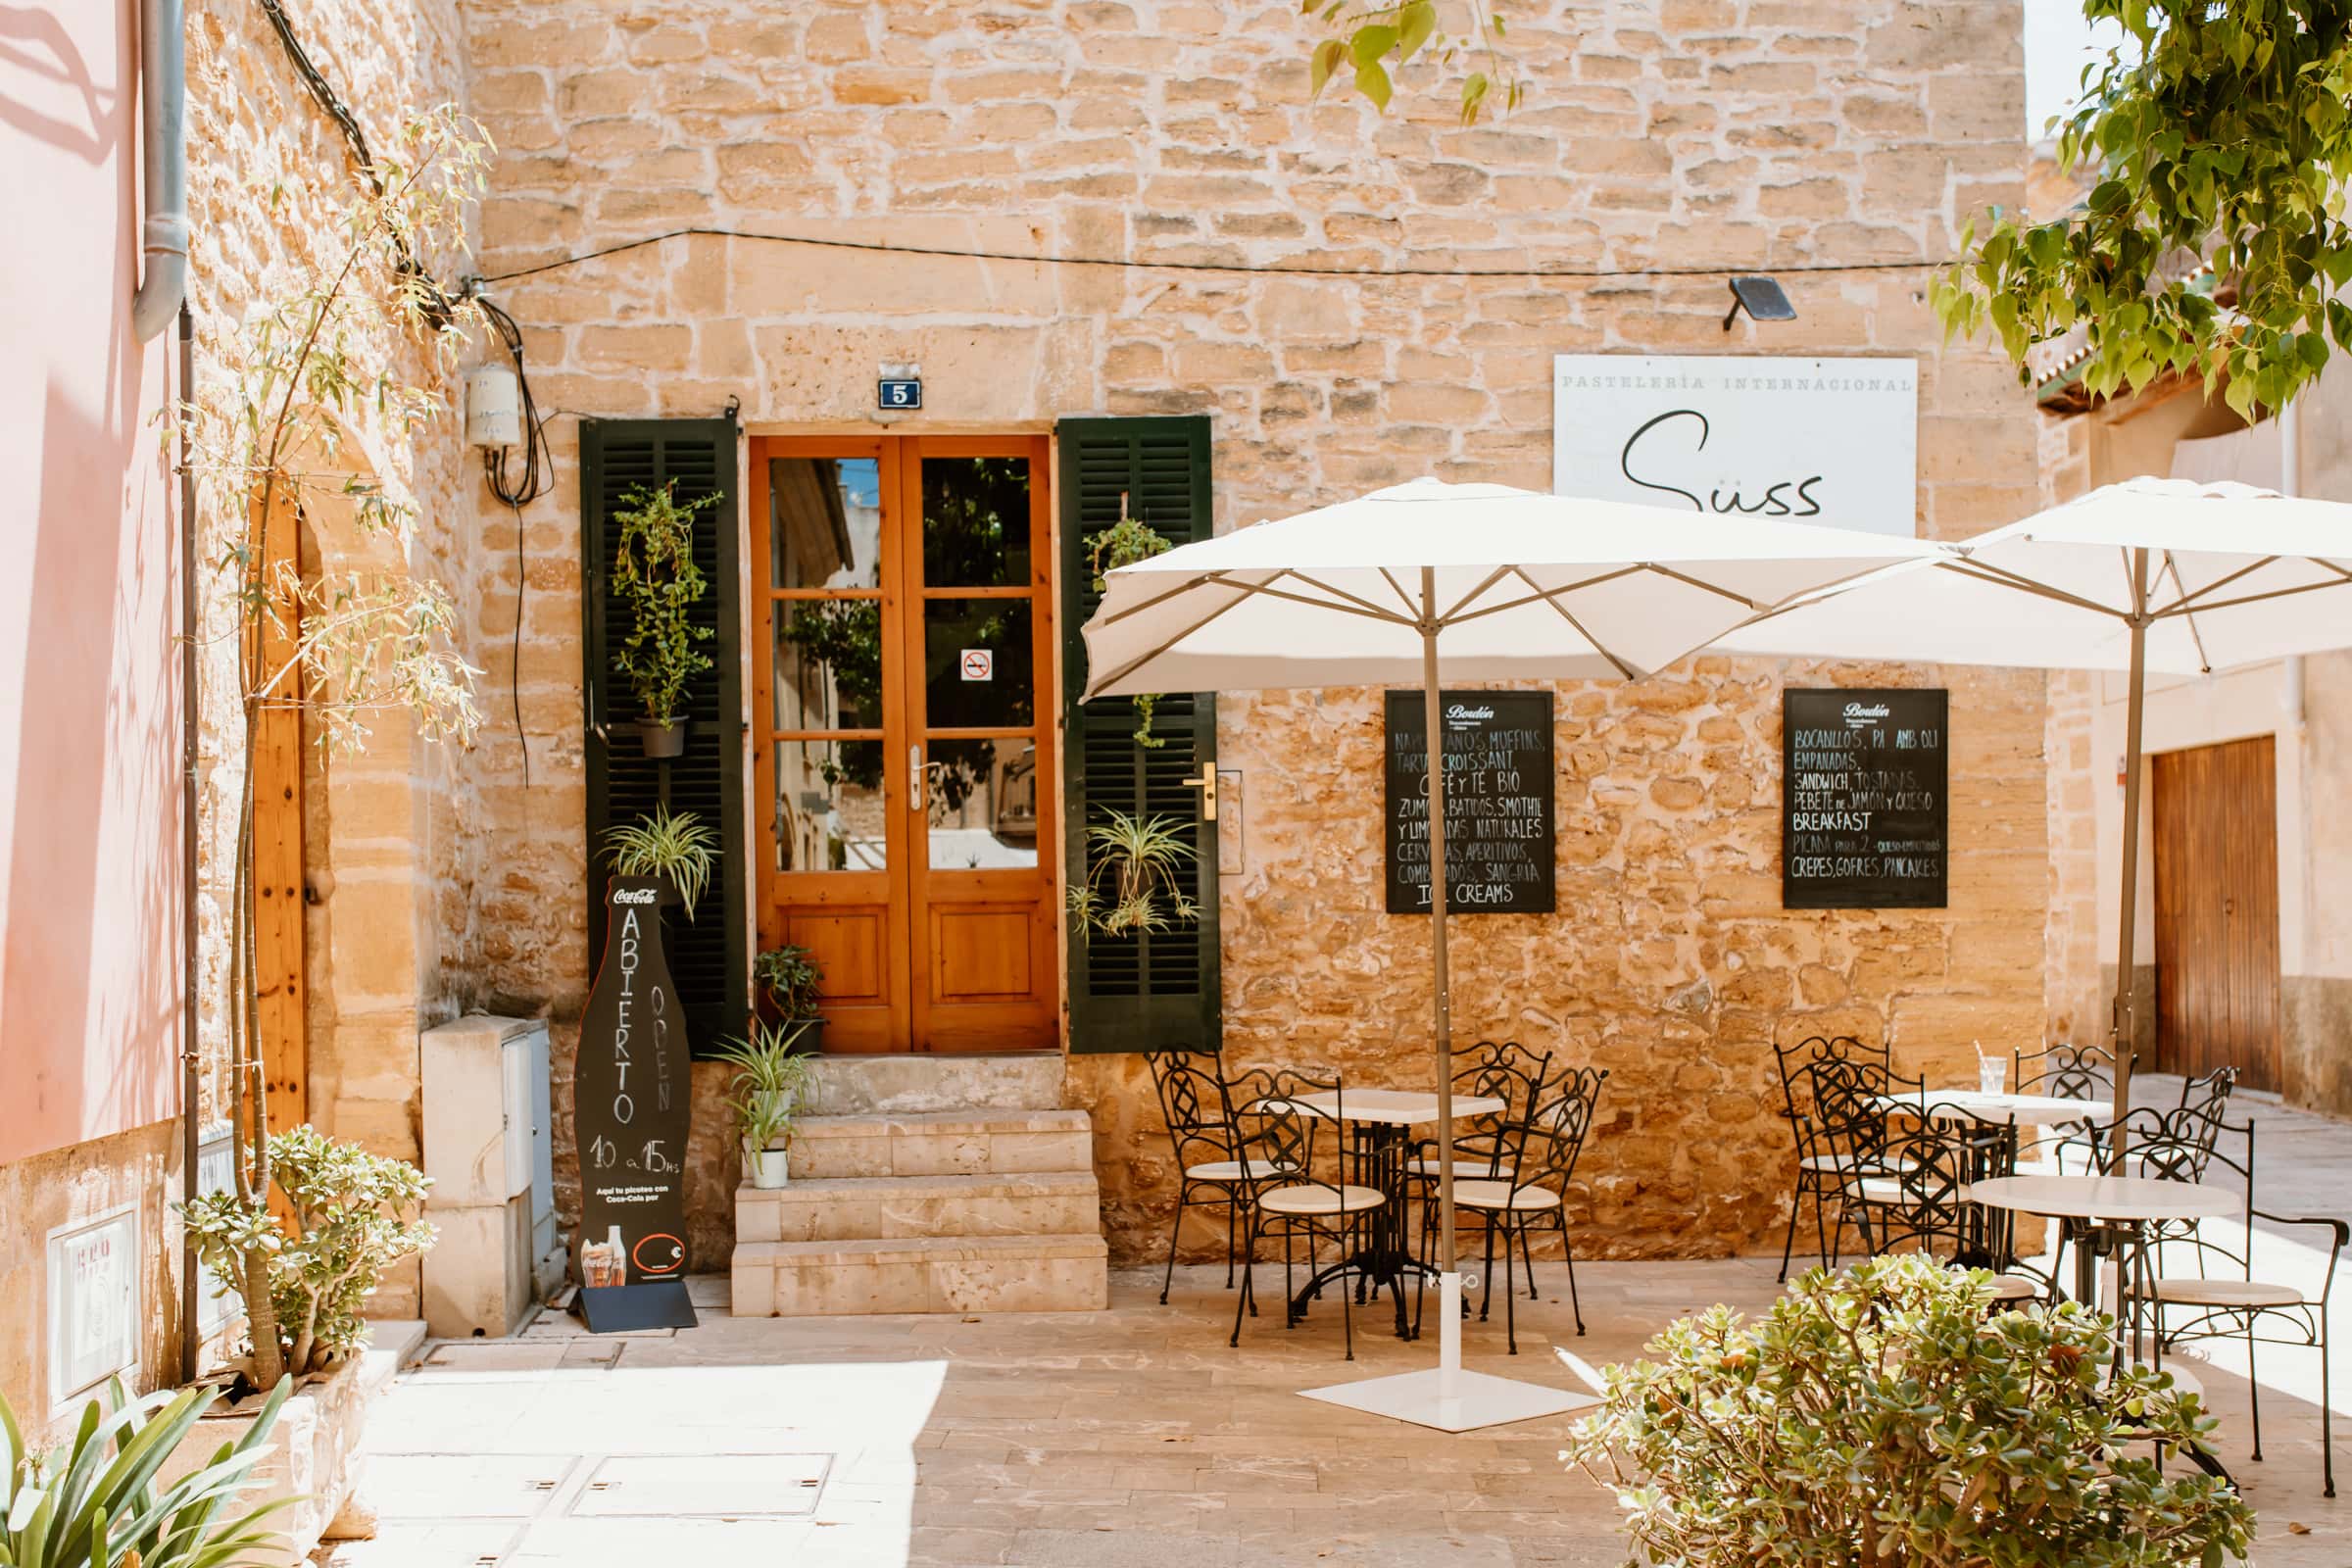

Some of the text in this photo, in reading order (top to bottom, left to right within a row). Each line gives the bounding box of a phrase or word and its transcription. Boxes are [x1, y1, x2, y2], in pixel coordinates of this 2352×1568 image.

[893, 384, 907, 404] 5
[1724, 377, 1912, 392] INTERNACIONAL
[1622, 410, 1823, 516] Süss
[1921, 729, 1937, 749] OLI
[1497, 770, 1520, 793] BIO
[1397, 823, 1406, 840] Y
[1476, 818, 1544, 840] NATURALES
[1792, 811, 1873, 832] BREAKFAST
[1884, 857, 1940, 879] PANCAKES
[1455, 883, 1514, 904] CREAMS
[613, 907, 641, 1125] ABIERTO
[650, 985, 670, 1113] OPEN
[590, 1134, 616, 1168] 10
